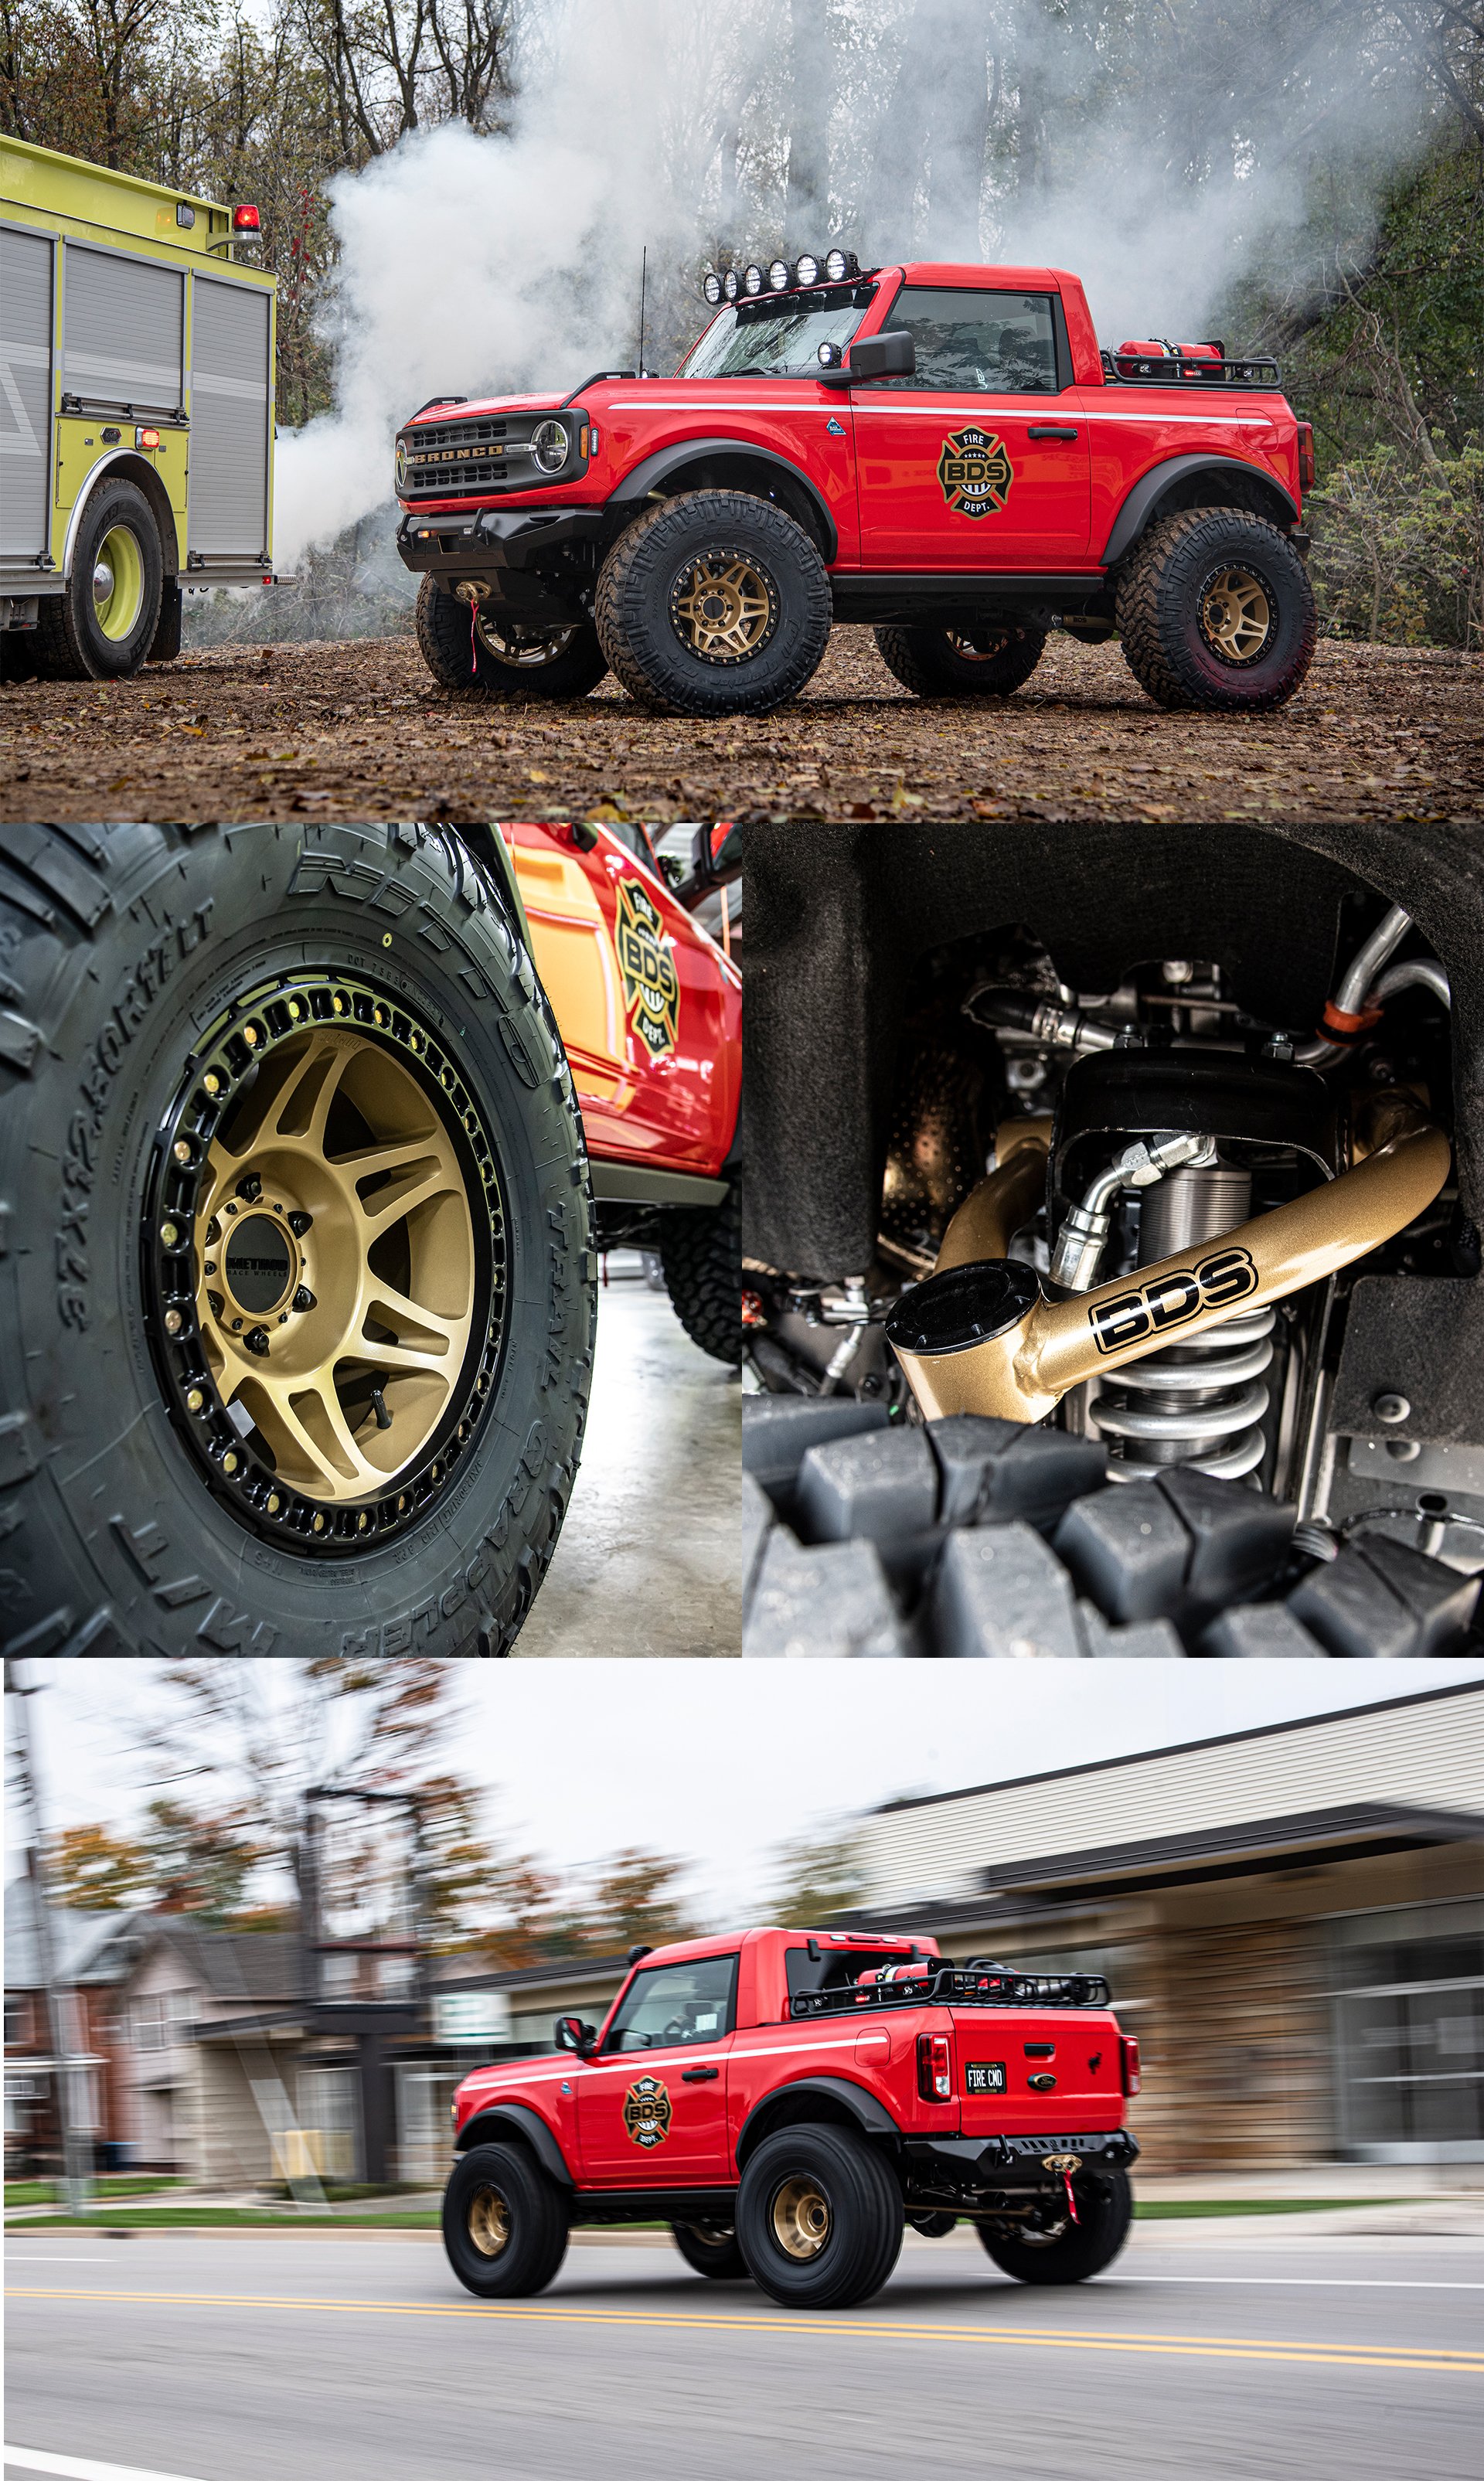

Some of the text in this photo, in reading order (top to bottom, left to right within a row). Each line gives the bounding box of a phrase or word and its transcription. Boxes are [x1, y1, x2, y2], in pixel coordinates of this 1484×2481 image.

[963, 434, 984, 445] FIRE
[414, 445, 503, 464] BRONCO
[945, 460, 1006, 484] BDS
[963, 501, 990, 512] DEPT.
[633, 892, 654, 923] FIRE
[348, 953, 365, 968] DOT
[624, 926, 674, 1000] BDS
[226, 1257, 288, 1271] METHOD
[1088, 1247, 1259, 1355] BDS
[968, 2069, 1003, 2087] FIRE CMD
[628, 2100, 668, 2123] BDS
